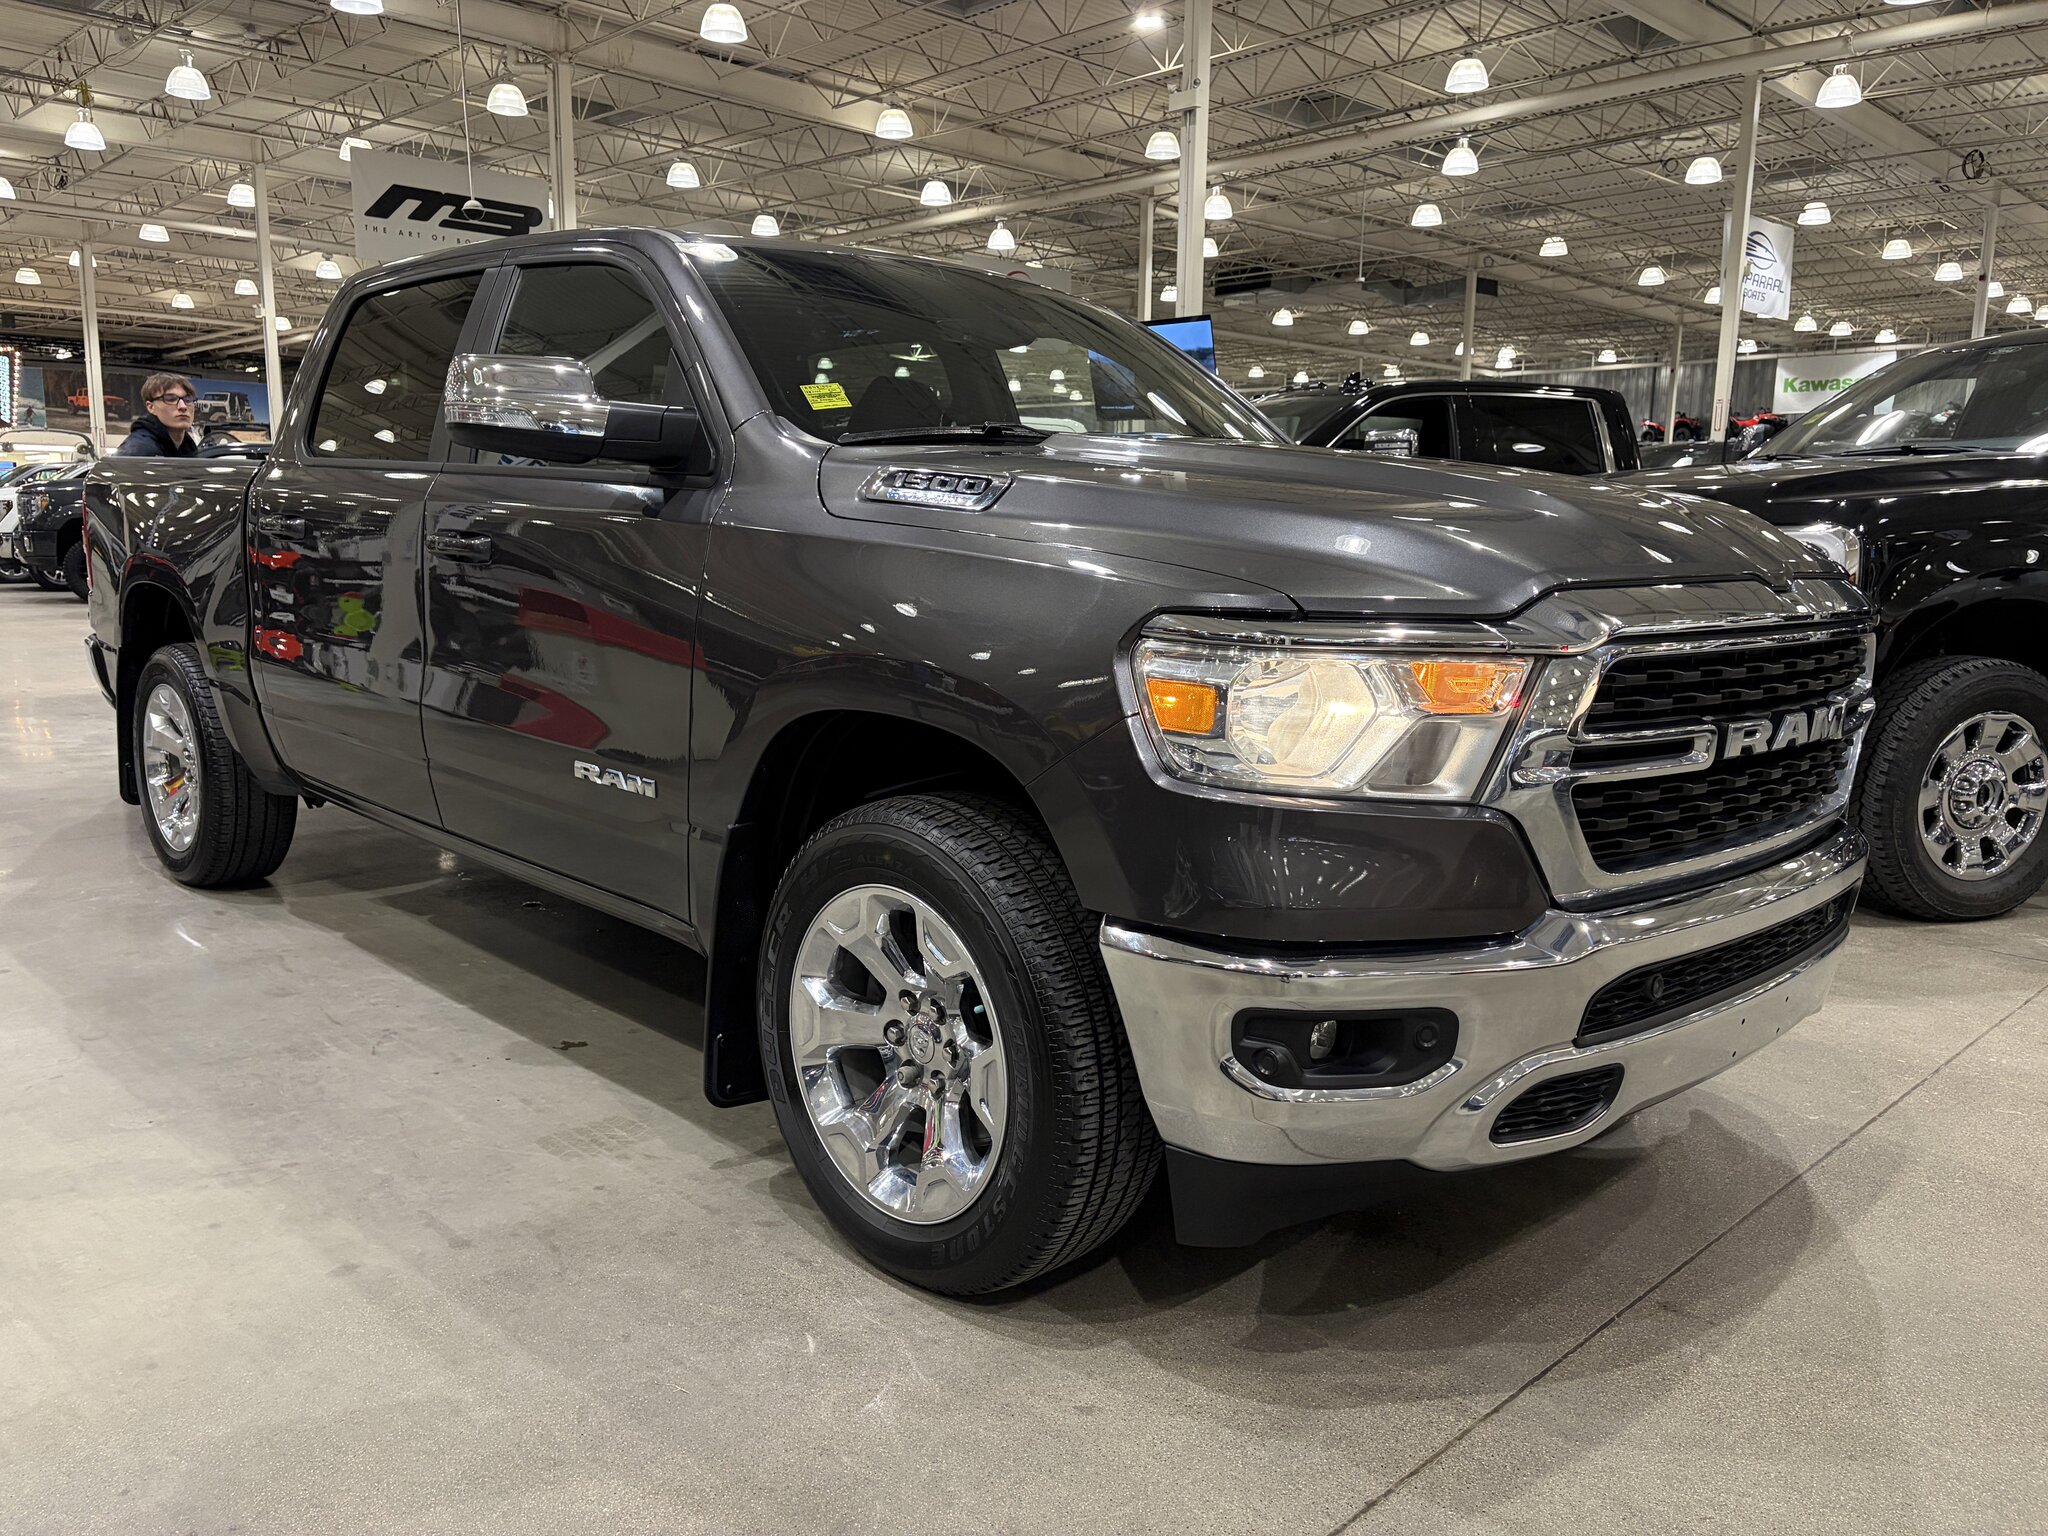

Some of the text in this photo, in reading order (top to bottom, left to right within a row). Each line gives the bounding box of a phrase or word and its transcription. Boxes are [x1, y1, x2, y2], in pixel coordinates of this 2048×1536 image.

[364, 224, 387, 234] THE
[398, 229, 421, 239] ART
[431, 234, 446, 242] OF
[1742, 271, 1785, 294] PARRAL
[1783, 376, 1857, 393] Kawas
[892, 471, 986, 494] 1500
[1723, 701, 1846, 760] RAM
[574, 759, 657, 799] RAM
[760, 901, 794, 1105] DUELER
